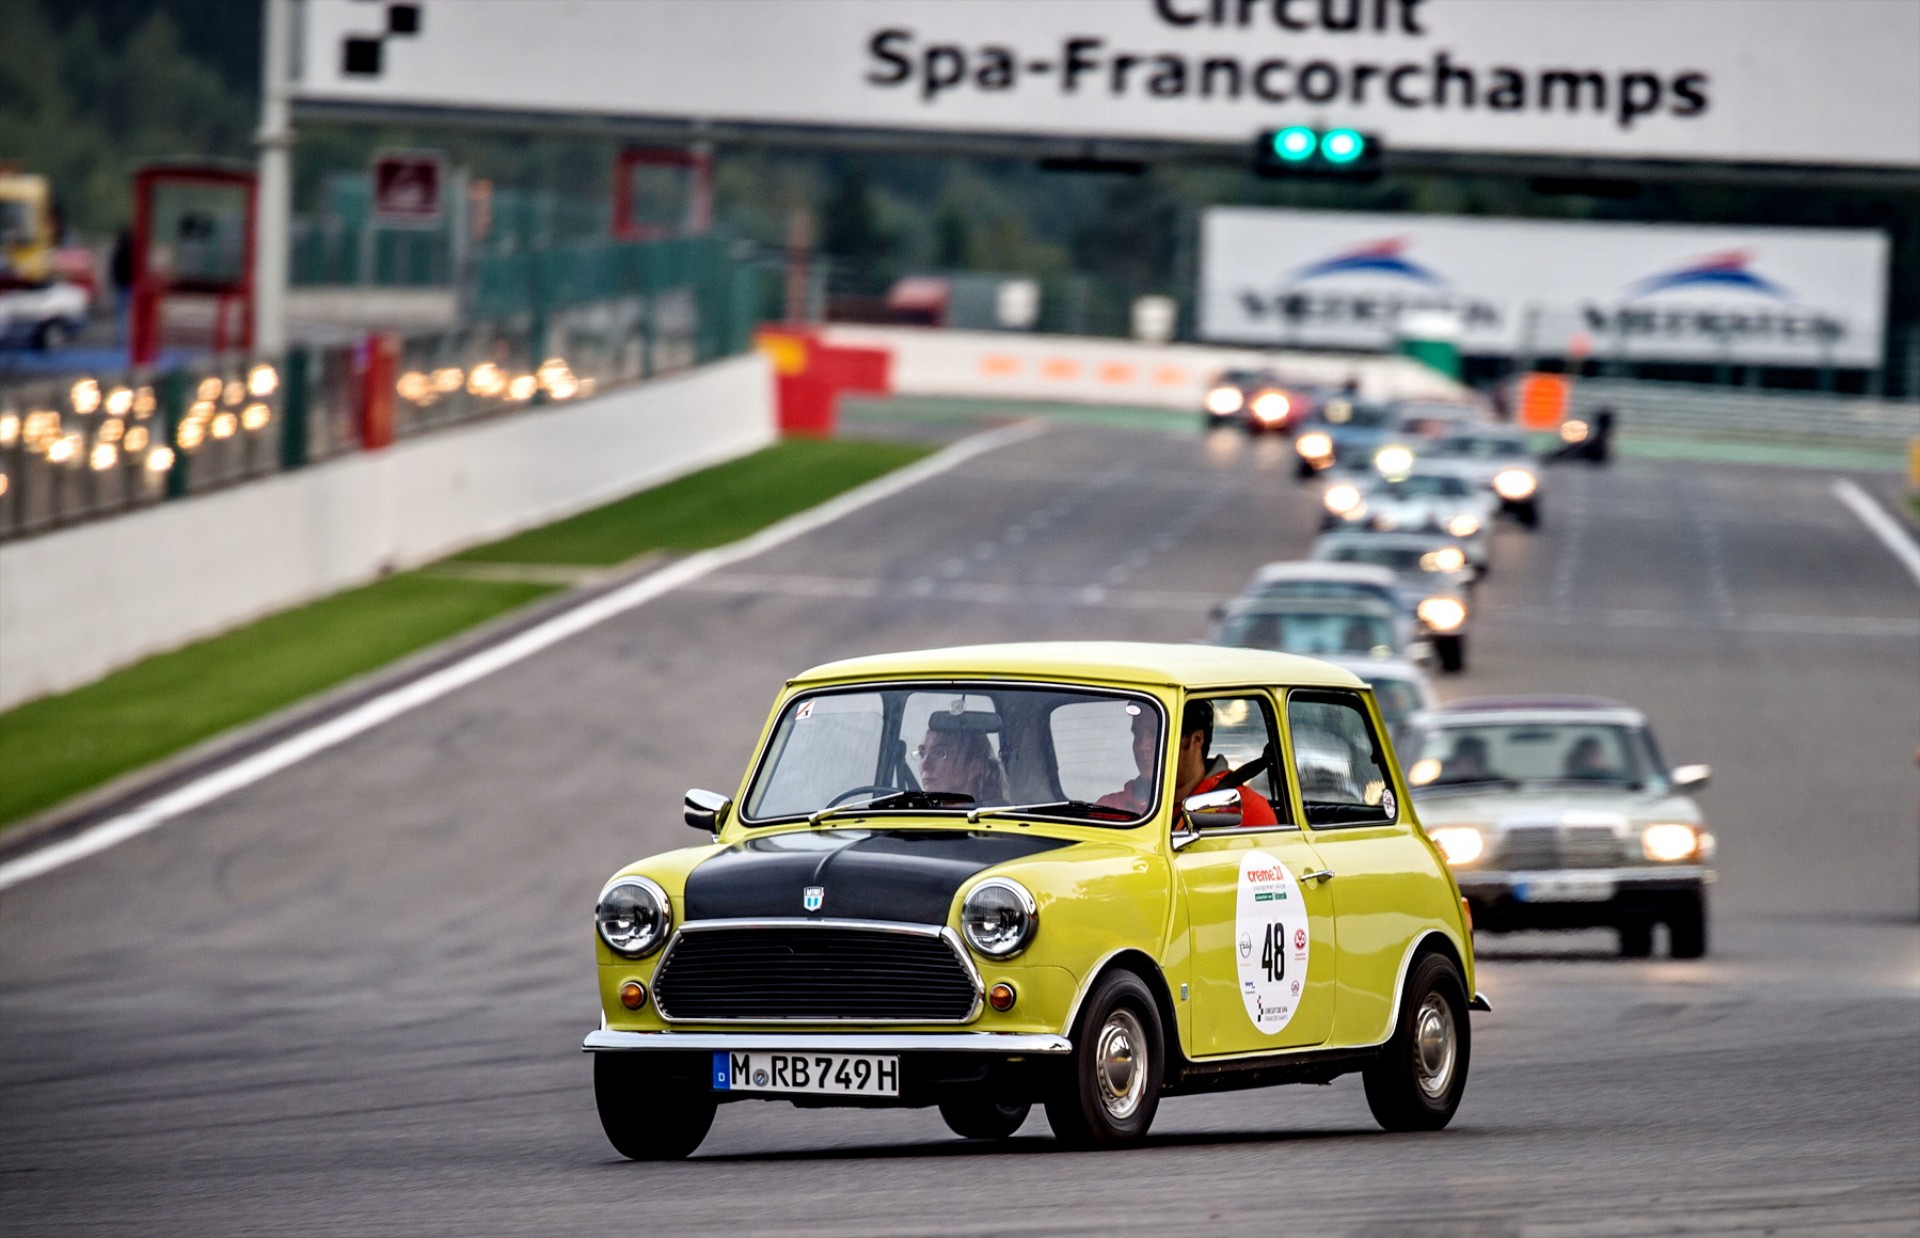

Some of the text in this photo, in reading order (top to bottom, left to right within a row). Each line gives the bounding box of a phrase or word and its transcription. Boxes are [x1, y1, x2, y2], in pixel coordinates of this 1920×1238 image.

[866, 30, 1709, 126] Spa-Francorchamps
[1247, 865, 1284, 883] creme 21
[1262, 922, 1285, 982] 48
